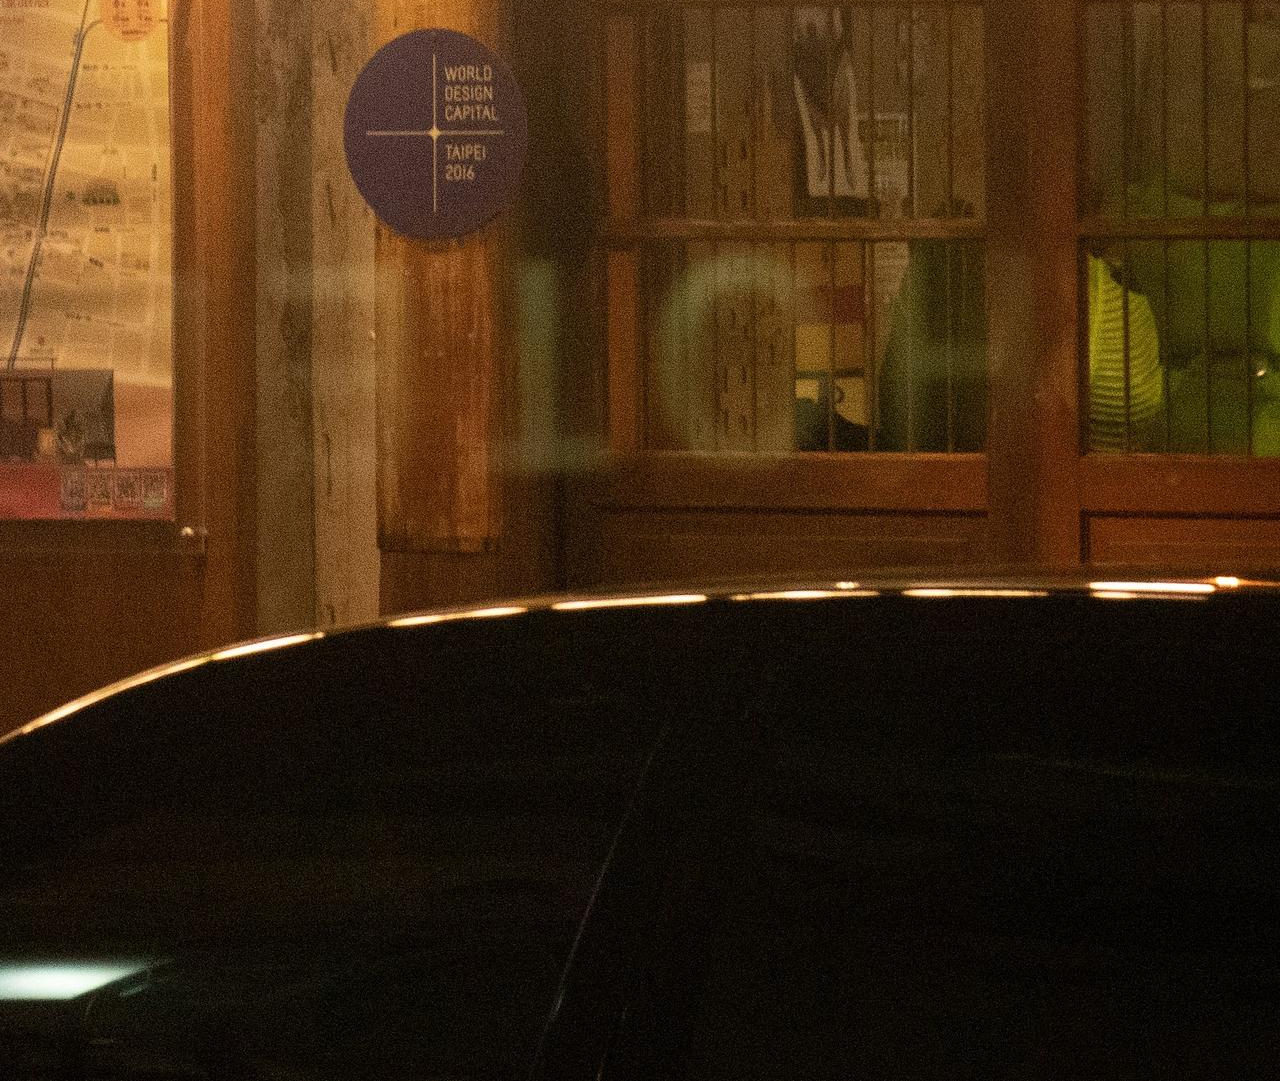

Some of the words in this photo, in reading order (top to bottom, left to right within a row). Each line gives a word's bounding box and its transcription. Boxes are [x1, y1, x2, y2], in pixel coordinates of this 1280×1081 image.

[444, 64, 493, 82] WORLD
[444, 85, 494, 101] DESIGN
[444, 105, 498, 121] CAPITAL
[446, 144, 487, 161] TAIPEI
[445, 164, 475, 181] 2016
